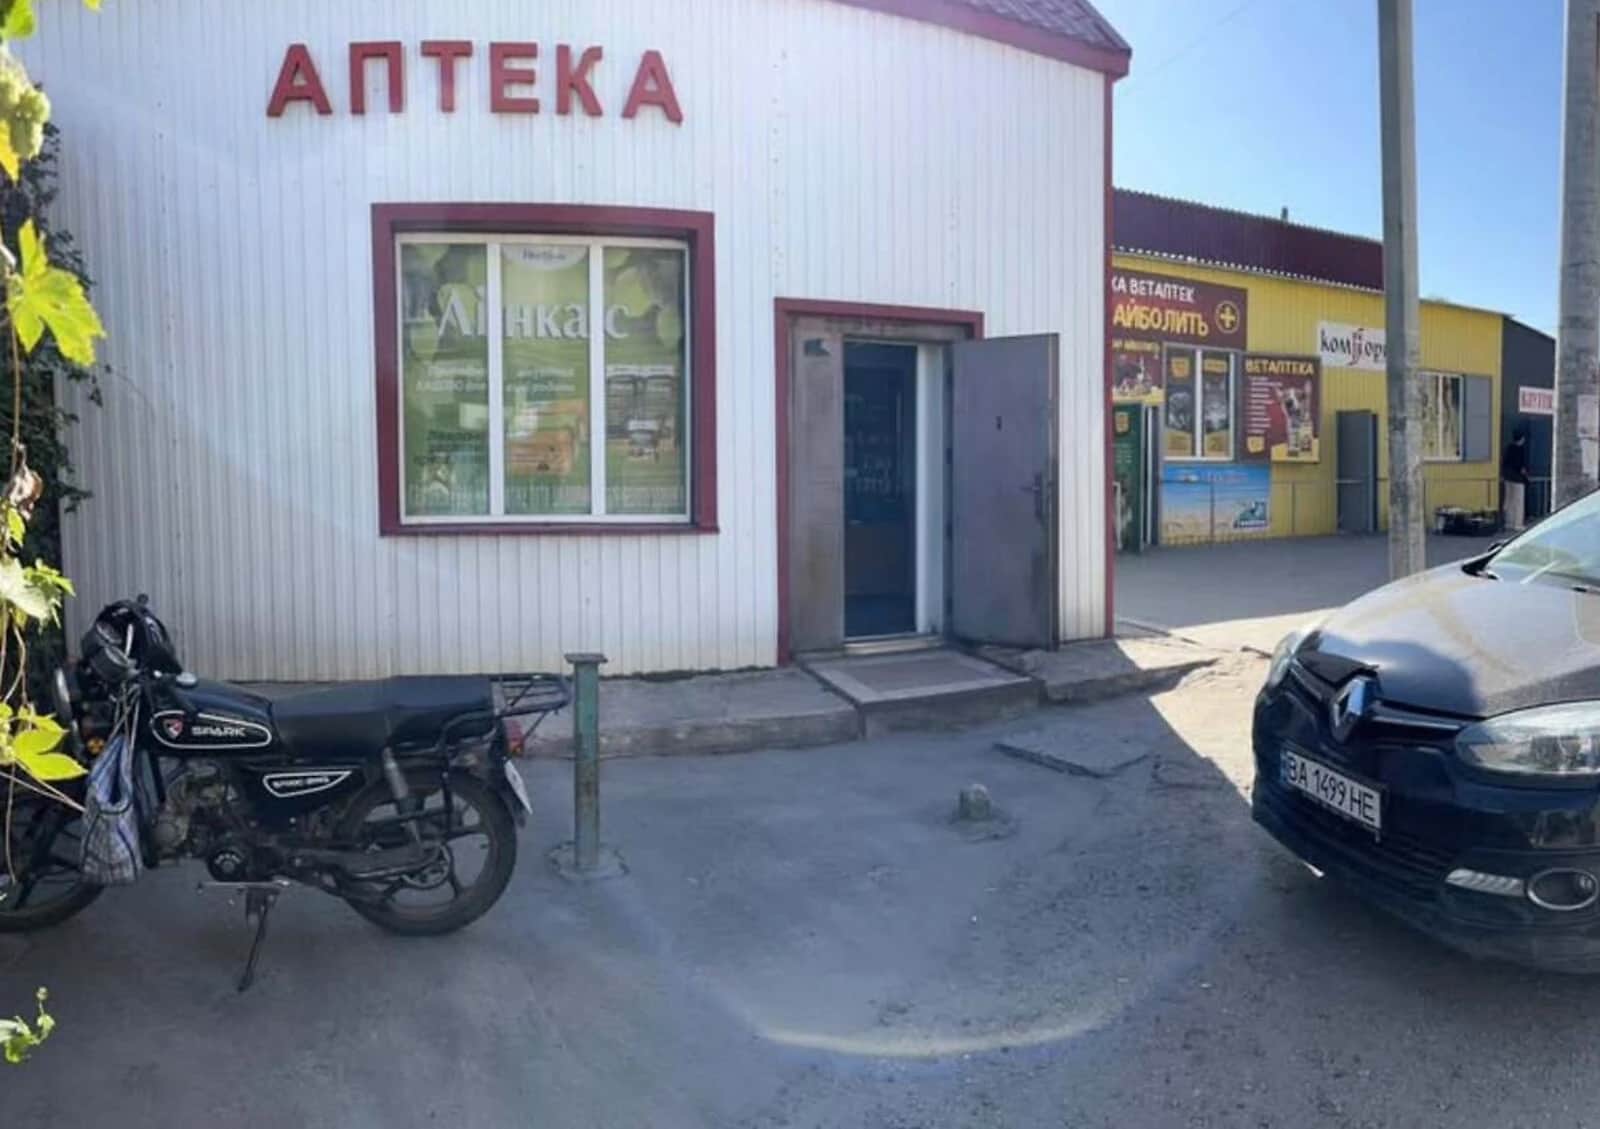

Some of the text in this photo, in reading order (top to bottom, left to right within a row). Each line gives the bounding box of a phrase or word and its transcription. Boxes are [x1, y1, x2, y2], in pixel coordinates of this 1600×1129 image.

[266, 41, 684, 126] АПТЕКА
[1129, 278, 1195, 304] ВЕТАПТЕК
[1113, 298, 1209, 337] АЙБОЛИТЬ
[1321, 328, 1387, 366] комфор
[1246, 359, 1314, 376] ВЕТАПТЕКА
[192, 725, 247, 738] SPARK
[1287, 755, 1377, 824] BA 1499 HE
